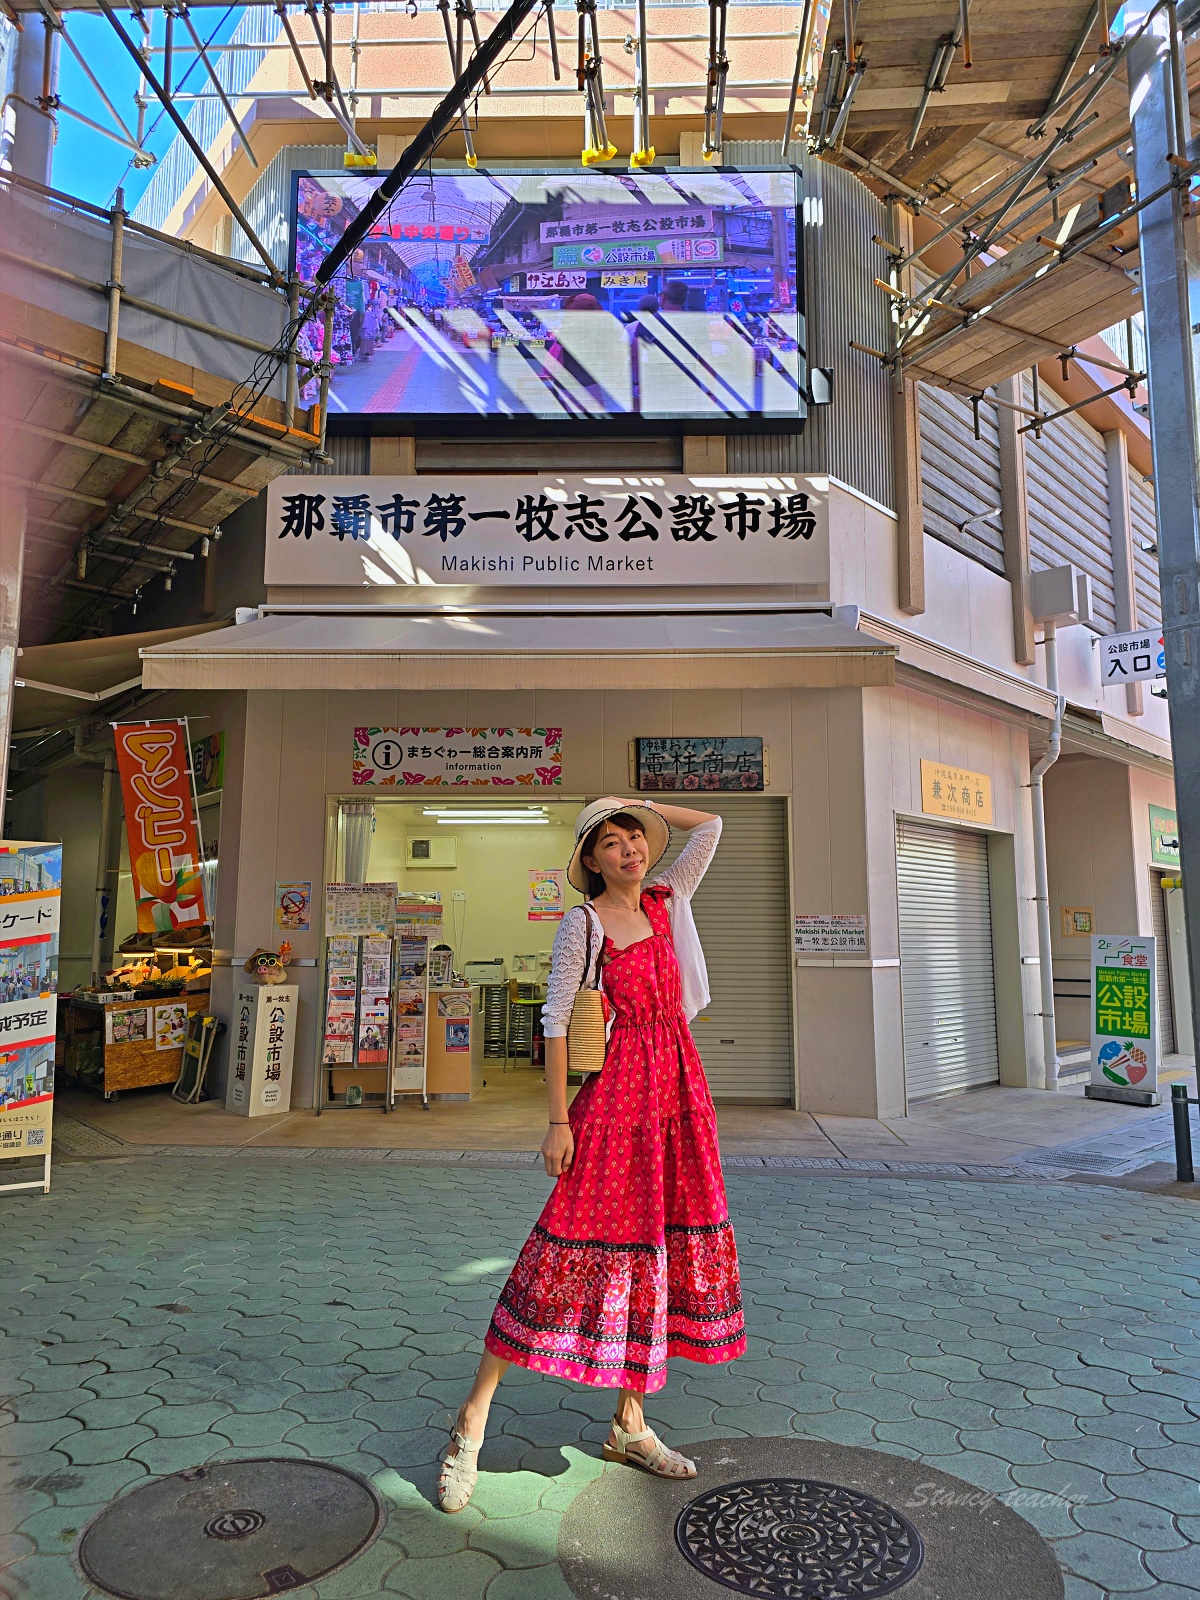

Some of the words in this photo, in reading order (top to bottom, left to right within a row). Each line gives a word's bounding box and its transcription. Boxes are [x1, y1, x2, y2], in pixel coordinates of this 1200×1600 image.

[368, 224, 470, 242] 市場中央通り
[545, 215, 706, 239] 那覇市第一牧志公設市場
[605, 250, 656, 263] 公設市場
[527, 272, 586, 289] 伊江島や
[603, 276, 647, 286] みき屋
[277, 492, 817, 543] 那覇市第一牧志公設市場
[441, 554, 515, 572] Makishi
[523, 554, 580, 572] Public
[587, 554, 654, 572] Market
[1108, 638, 1151, 654] 公設市場
[1107, 654, 1151, 678] 入口
[641, 738, 727, 752] 沖縄おみやげ
[445, 761, 502, 772] information
[645, 750, 755, 776] 電柱商店
[932, 779, 984, 808] 兼次商店
[0, 908, 52, 928] ケード
[795, 936, 866, 946] 第一牧志公設市場
[1098, 939, 1112, 950] 2F
[1121, 954, 1148, 967] 食堂
[1098, 974, 1148, 984] 那覇市第一牧志
[265, 995, 291, 1004] 第一牧志
[1097, 984, 1149, 1009] 公設
[1097, 1008, 1149, 1035] 市場
[235, 1005, 250, 1082] 公設市場
[264, 1006, 285, 1082] 公設市場
[0, 1114, 39, 1123] しくはこちら！
[0, 1129, 23, 1140] 通り
